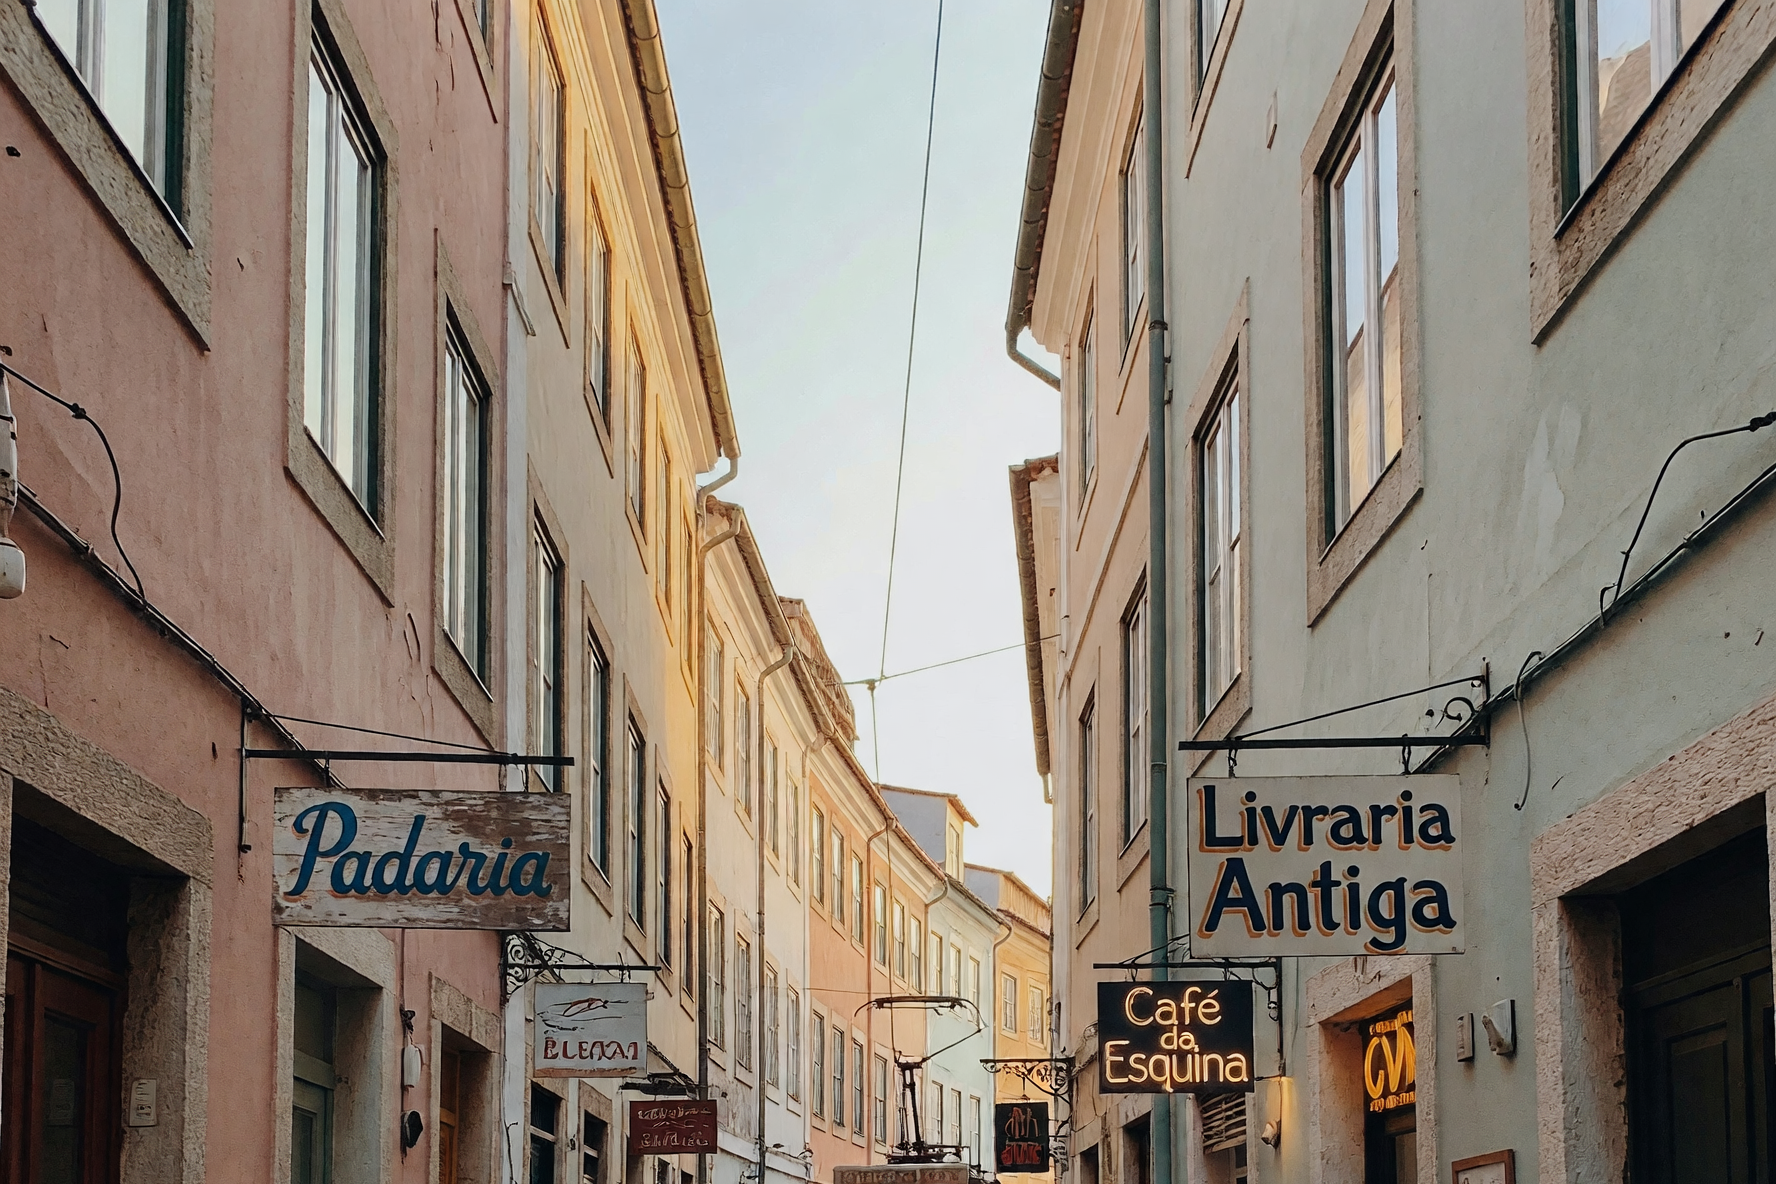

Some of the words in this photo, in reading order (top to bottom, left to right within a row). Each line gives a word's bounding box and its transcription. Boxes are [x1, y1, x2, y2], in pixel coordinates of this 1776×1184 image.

[1197, 784, 1456, 852] Livraria
[284, 801, 553, 898] Padaria
[1197, 857, 1457, 953] Antiga
[1124, 986, 1222, 1026] Café
[1103, 1040, 1249, 1092] Esquina
[1160, 1026, 1198, 1050] da
